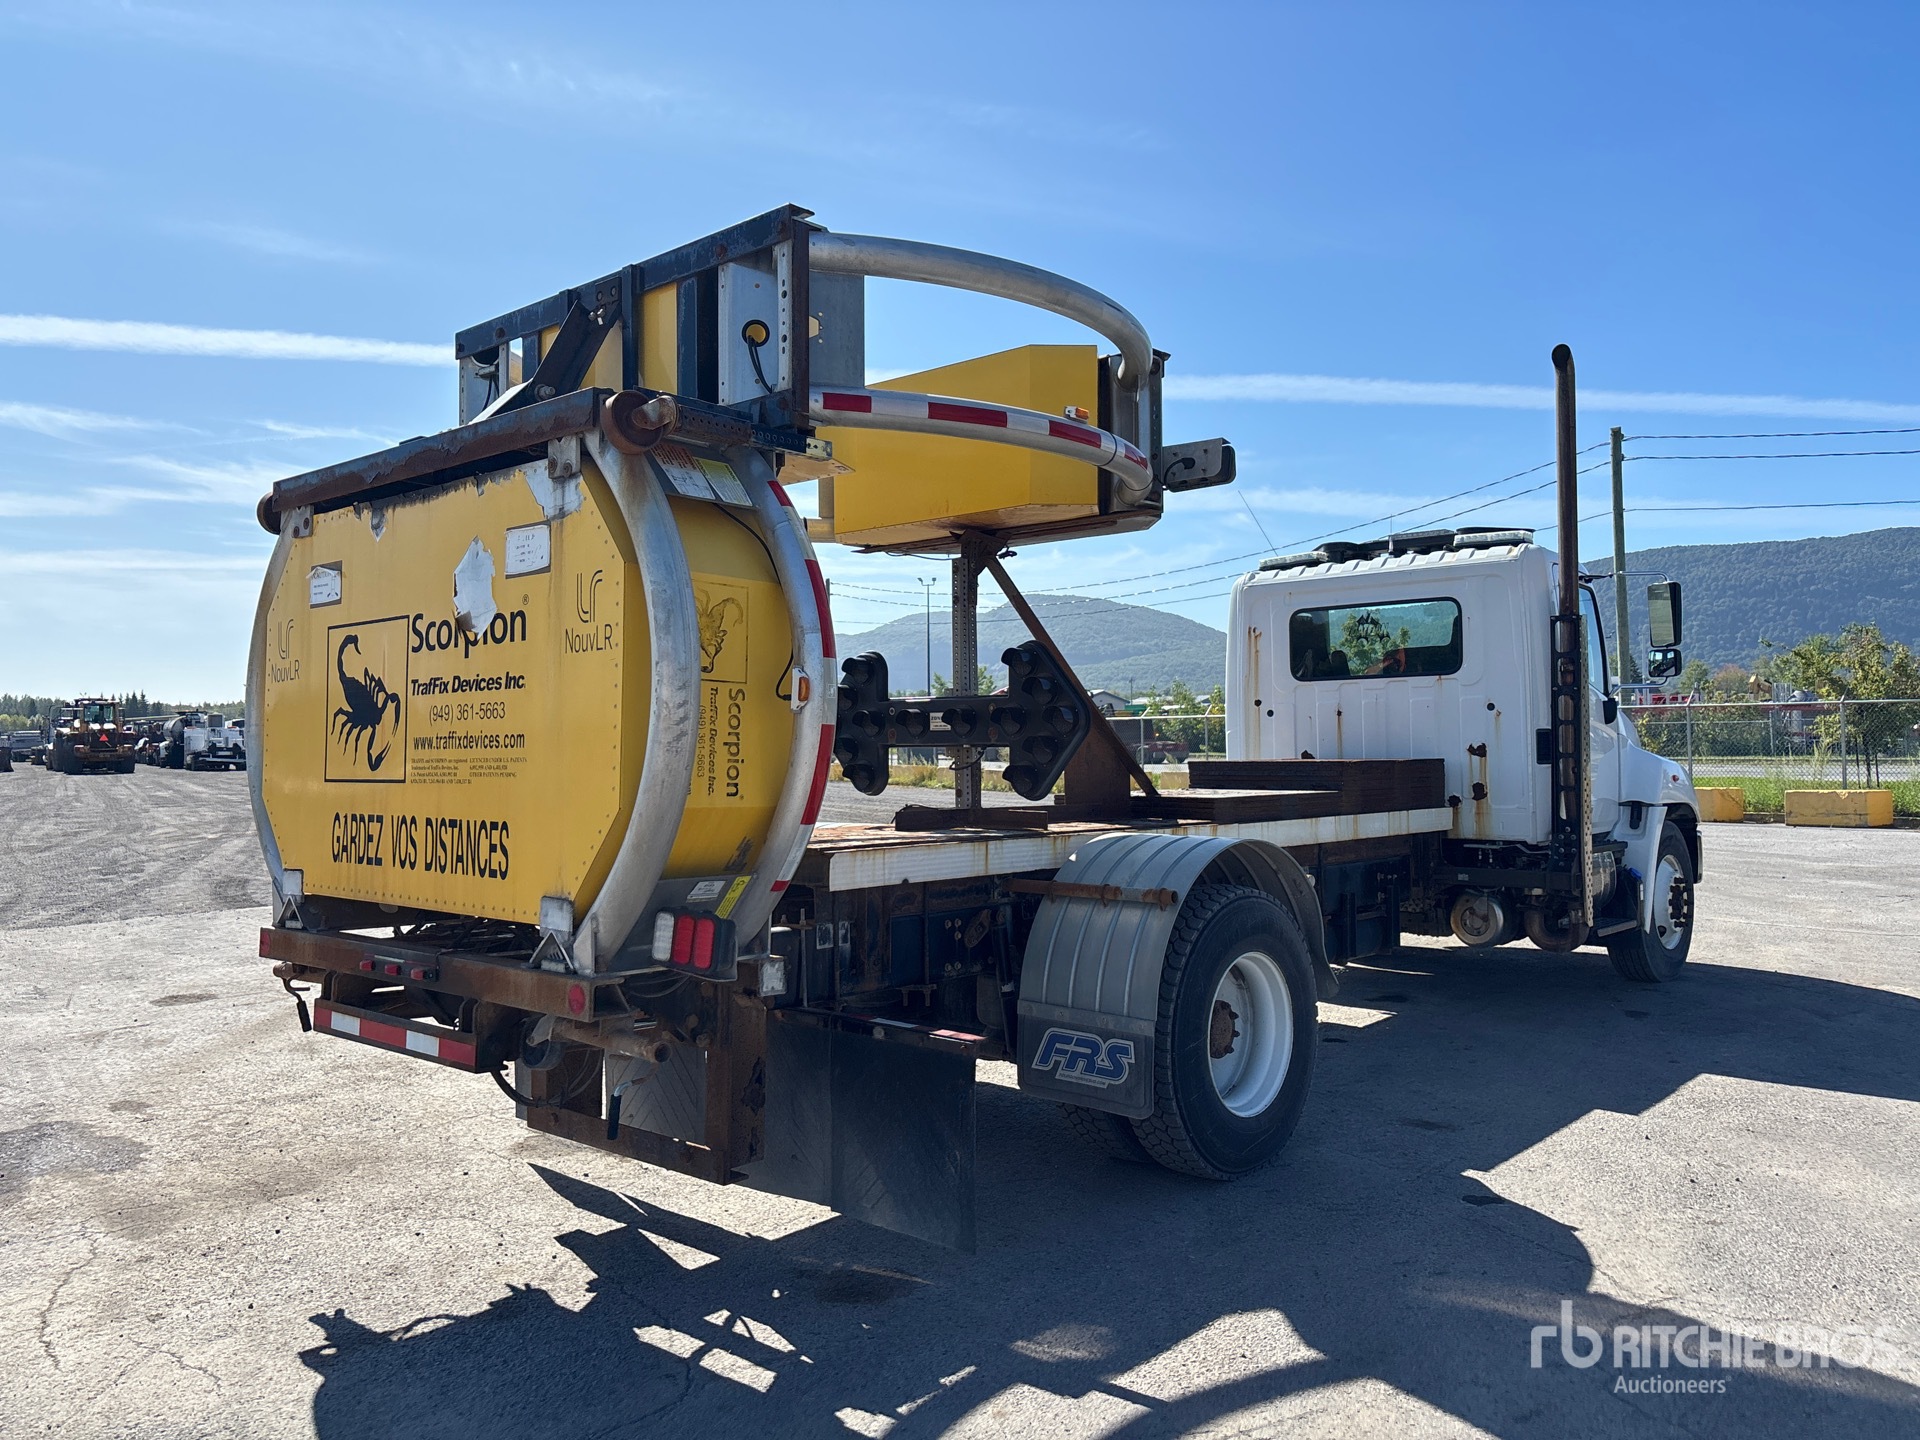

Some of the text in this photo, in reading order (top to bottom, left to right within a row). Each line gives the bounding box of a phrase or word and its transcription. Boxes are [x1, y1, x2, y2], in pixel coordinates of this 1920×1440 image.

[565, 623, 612, 654] NouvLR
[271, 659, 300, 683] NouvLR
[411, 677, 450, 696] TrafFix
[451, 673, 502, 694] Devices
[429, 701, 506, 726] (949) 361-5663
[413, 730, 525, 751] www.traffixdevices.com
[697, 733, 706, 778] 361-5663
[708, 728, 718, 774] Devices
[723, 688, 745, 797] Scorpion
[331, 811, 509, 881] GARDEZ VOS DISTANCES
[1035, 1030, 1132, 1081] FRS
